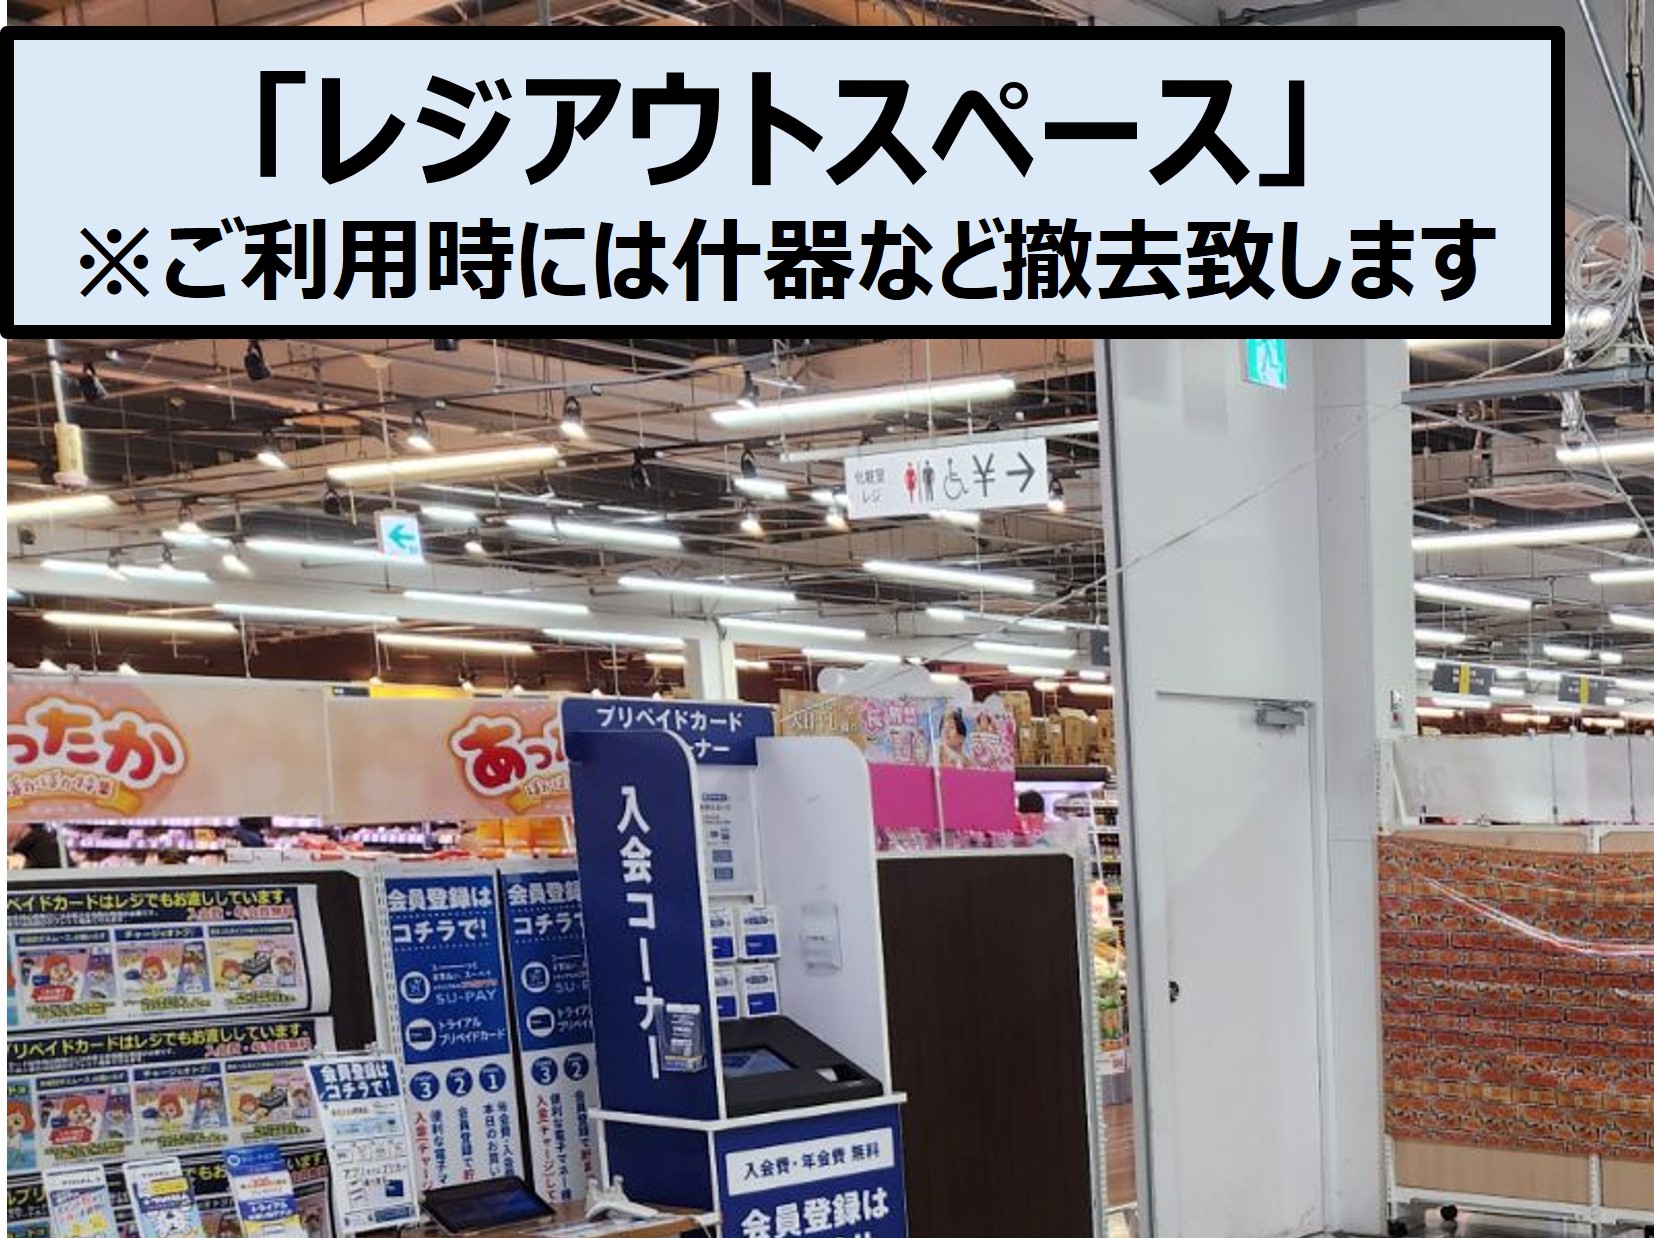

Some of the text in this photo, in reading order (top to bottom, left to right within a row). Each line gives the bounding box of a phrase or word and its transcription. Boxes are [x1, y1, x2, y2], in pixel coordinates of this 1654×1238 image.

[855, 468, 886, 484] 化粧室
[862, 491, 881, 503] レジ
[597, 706, 743, 732] プリペイドカード
[687, 739, 730, 758] ナー
[388, 887, 492, 911] 会員登録は
[392, 919, 488, 943] コチラで!
[617, 786, 665, 1080] 入会コーナー
[436, 989, 497, 1005] SU-PAY
[439, 1017, 481, 1031] トライアル
[439, 1029, 506, 1046] プリペイドカード
[540, 1067, 551, 1083] 3
[571, 1062, 582, 1077] 2
[420, 1082, 433, 1098] 3
[453, 1077, 466, 1094] 2
[487, 1074, 497, 1090] 1
[744, 1141, 880, 1180] 入会費・年会費 無料
